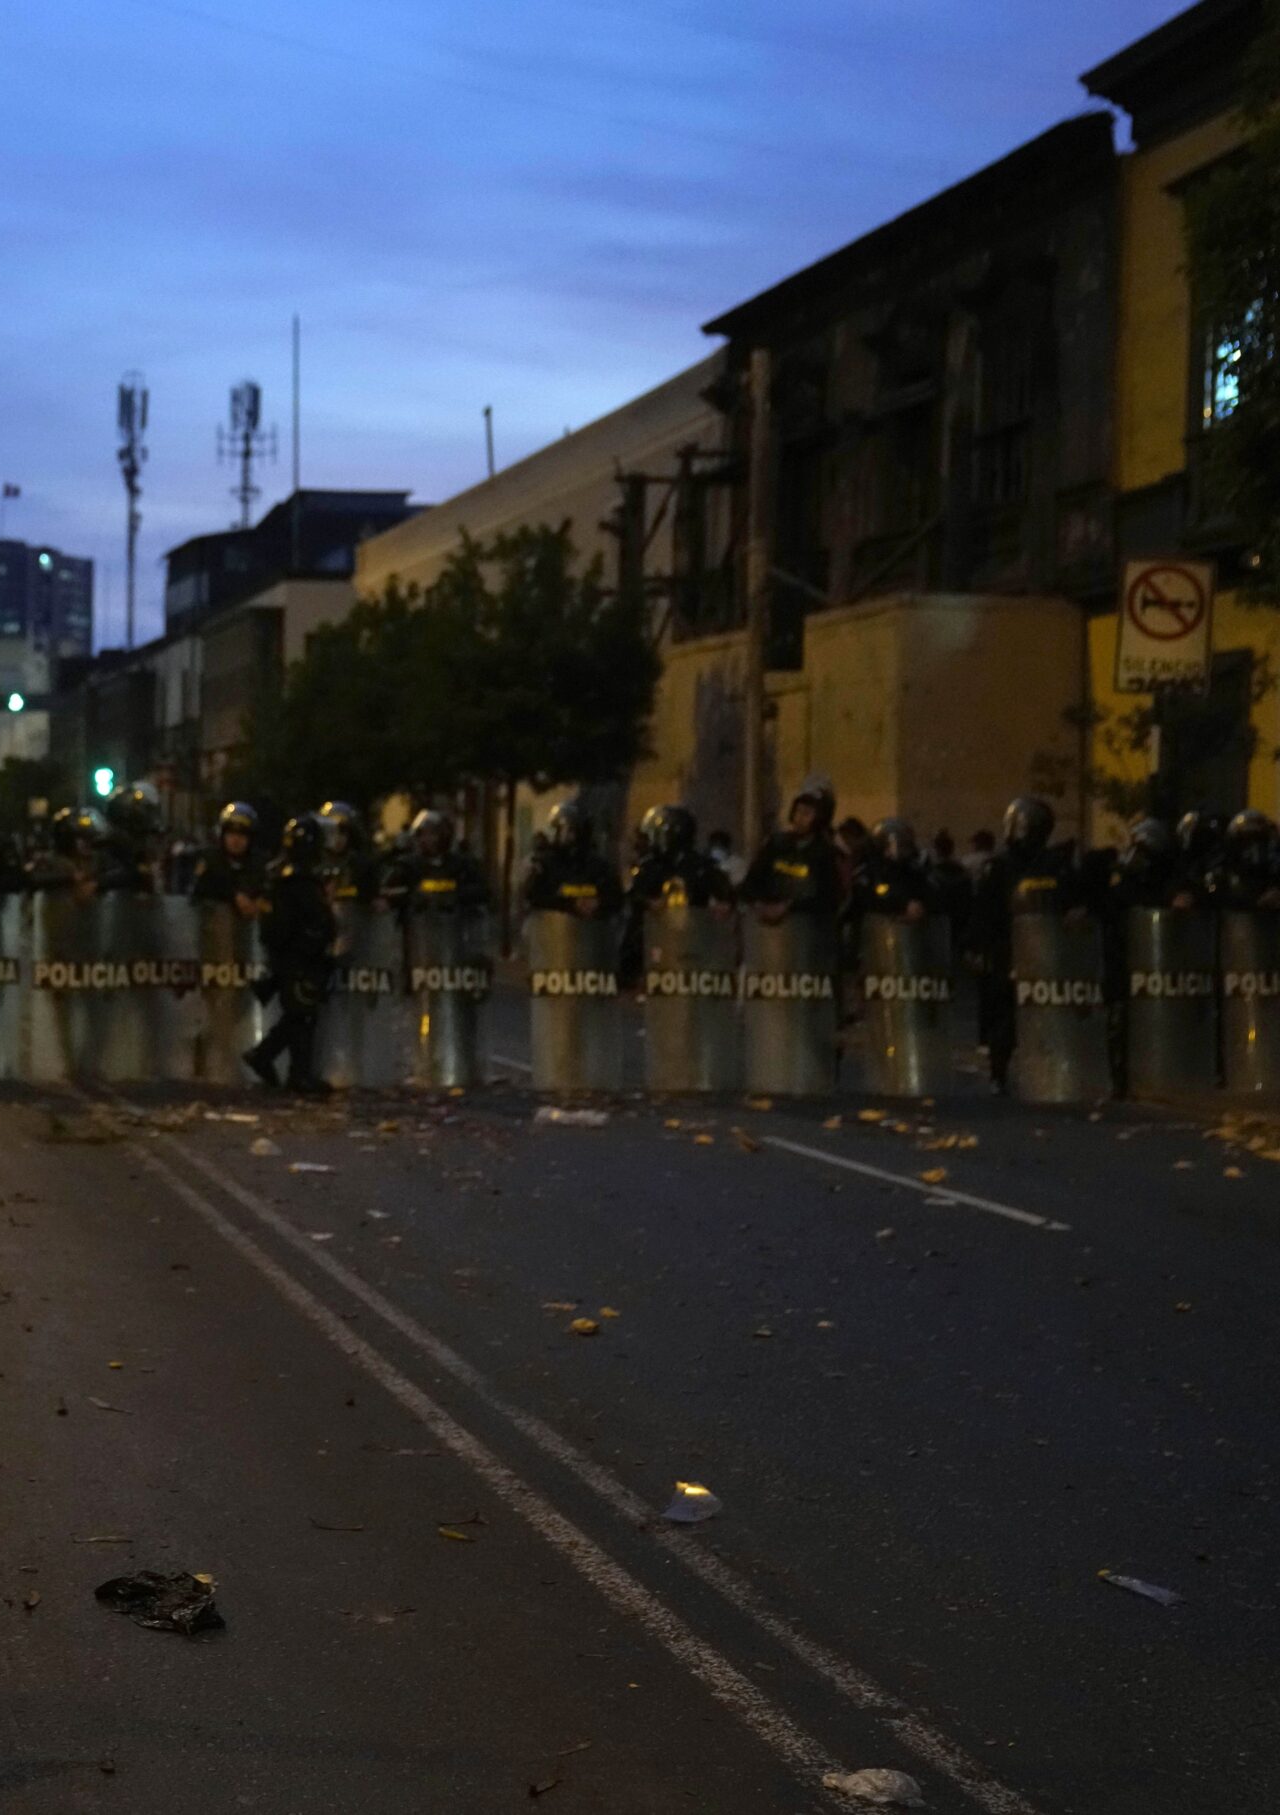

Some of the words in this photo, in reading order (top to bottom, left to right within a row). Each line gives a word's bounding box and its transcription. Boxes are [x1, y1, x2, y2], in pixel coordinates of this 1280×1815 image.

[34, 962, 131, 989] POLICIA
[532, 970, 618, 997] POLICIA
[646, 971, 733, 996] POLICIA
[747, 974, 834, 999] POLICIA
[865, 974, 950, 1000] POLICIA
[1017, 980, 1104, 1006] POLICIA
